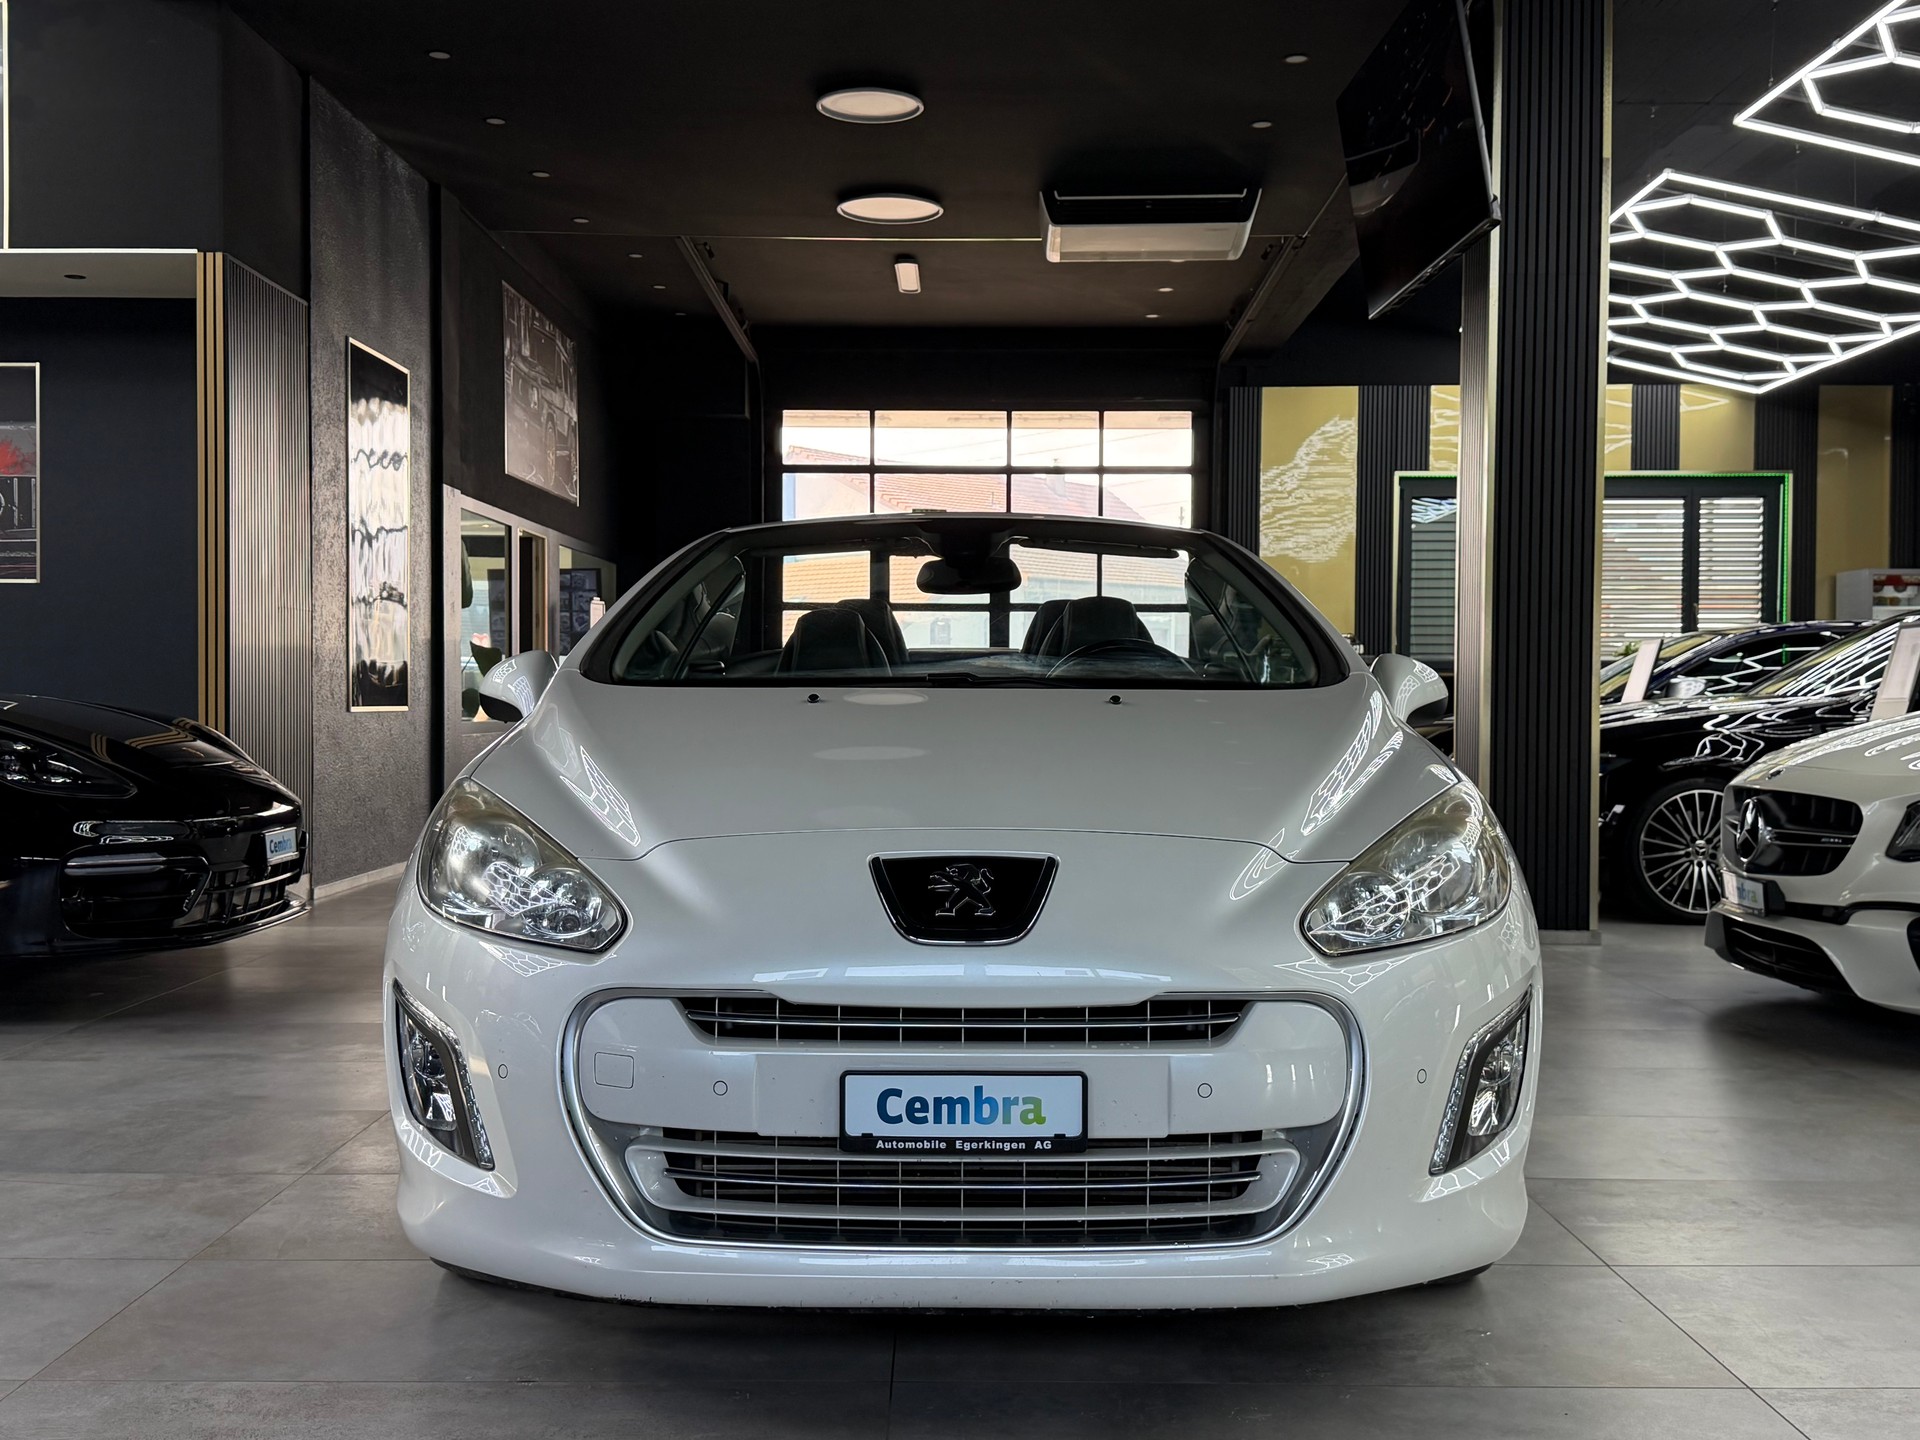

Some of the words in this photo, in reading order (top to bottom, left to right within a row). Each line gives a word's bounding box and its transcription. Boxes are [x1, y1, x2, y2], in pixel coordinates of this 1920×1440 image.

[876, 1085, 1047, 1125] Cembra
[875, 1139, 947, 1149] Automobile
[955, 1140, 1026, 1151] Egerkingen
[1034, 1140, 1052, 1149] AG
